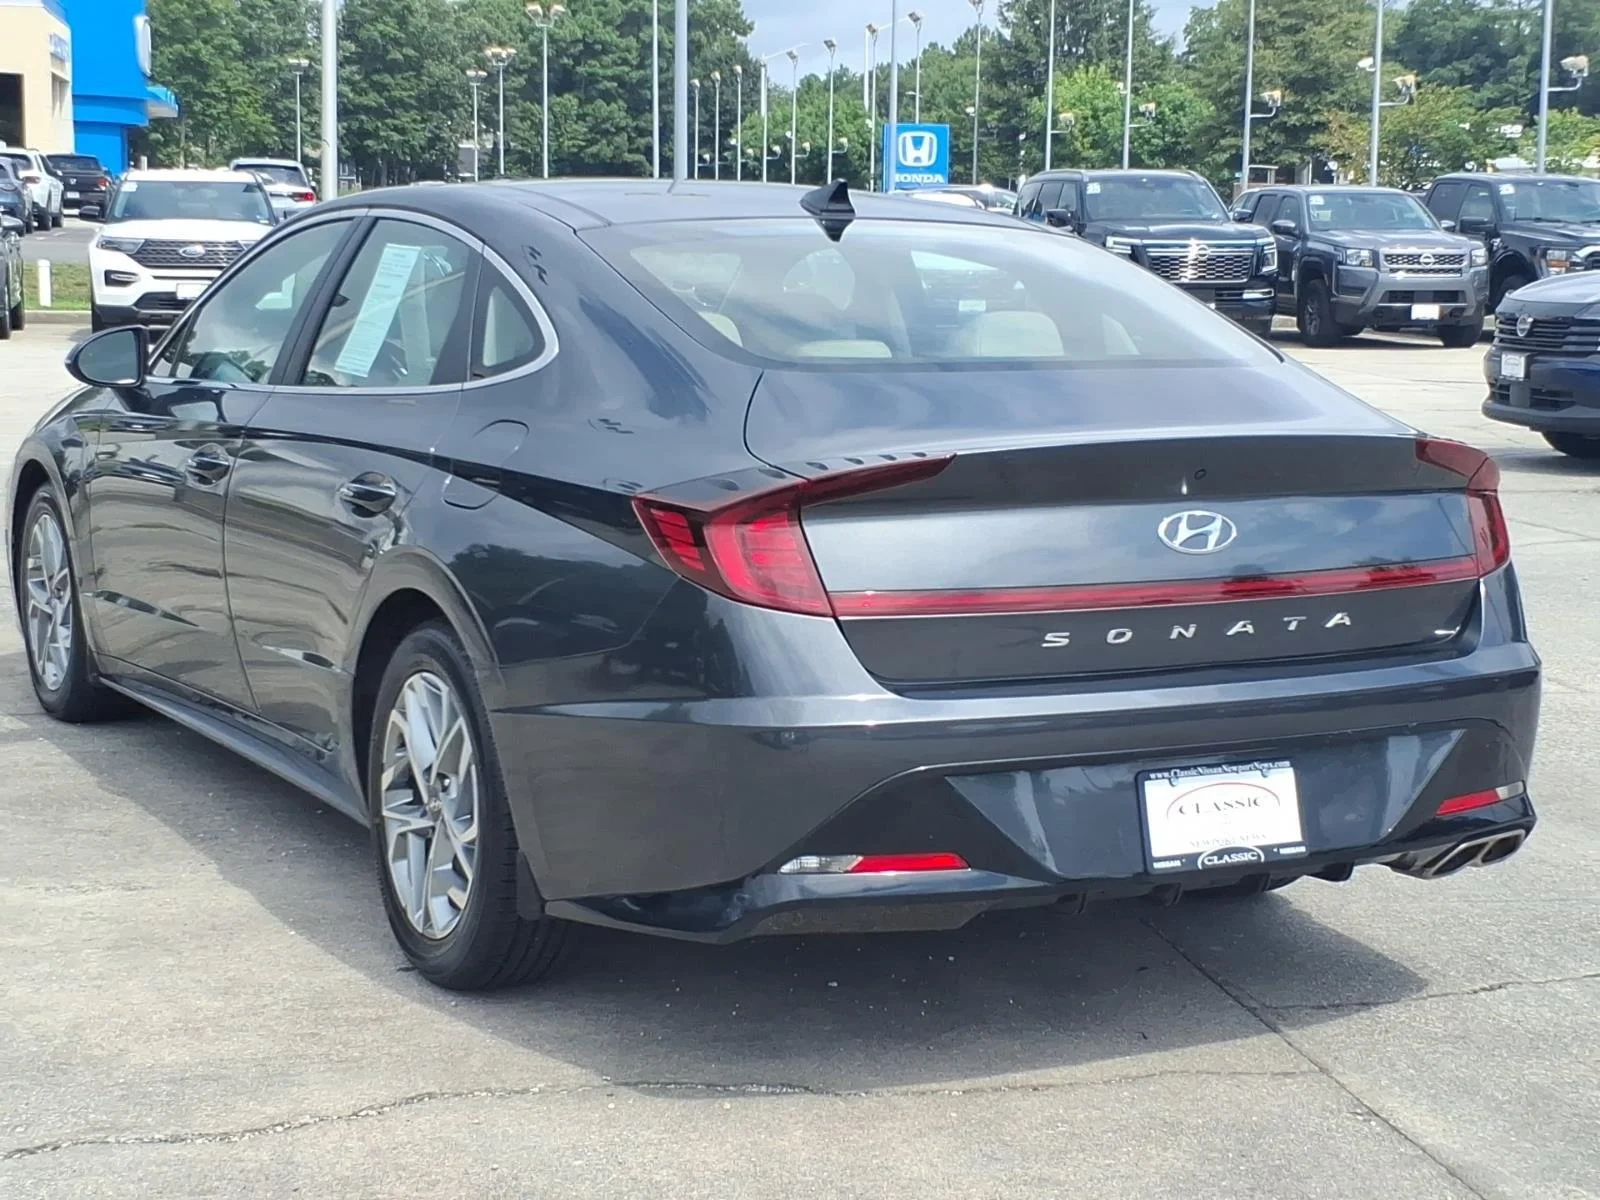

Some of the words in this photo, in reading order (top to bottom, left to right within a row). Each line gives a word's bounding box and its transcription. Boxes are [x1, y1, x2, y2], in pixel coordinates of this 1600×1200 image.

[1042, 612, 1352, 647] SONATA
[1179, 797, 1261, 814] CLASSIC
[1204, 852, 1258, 865] CLASSIC
